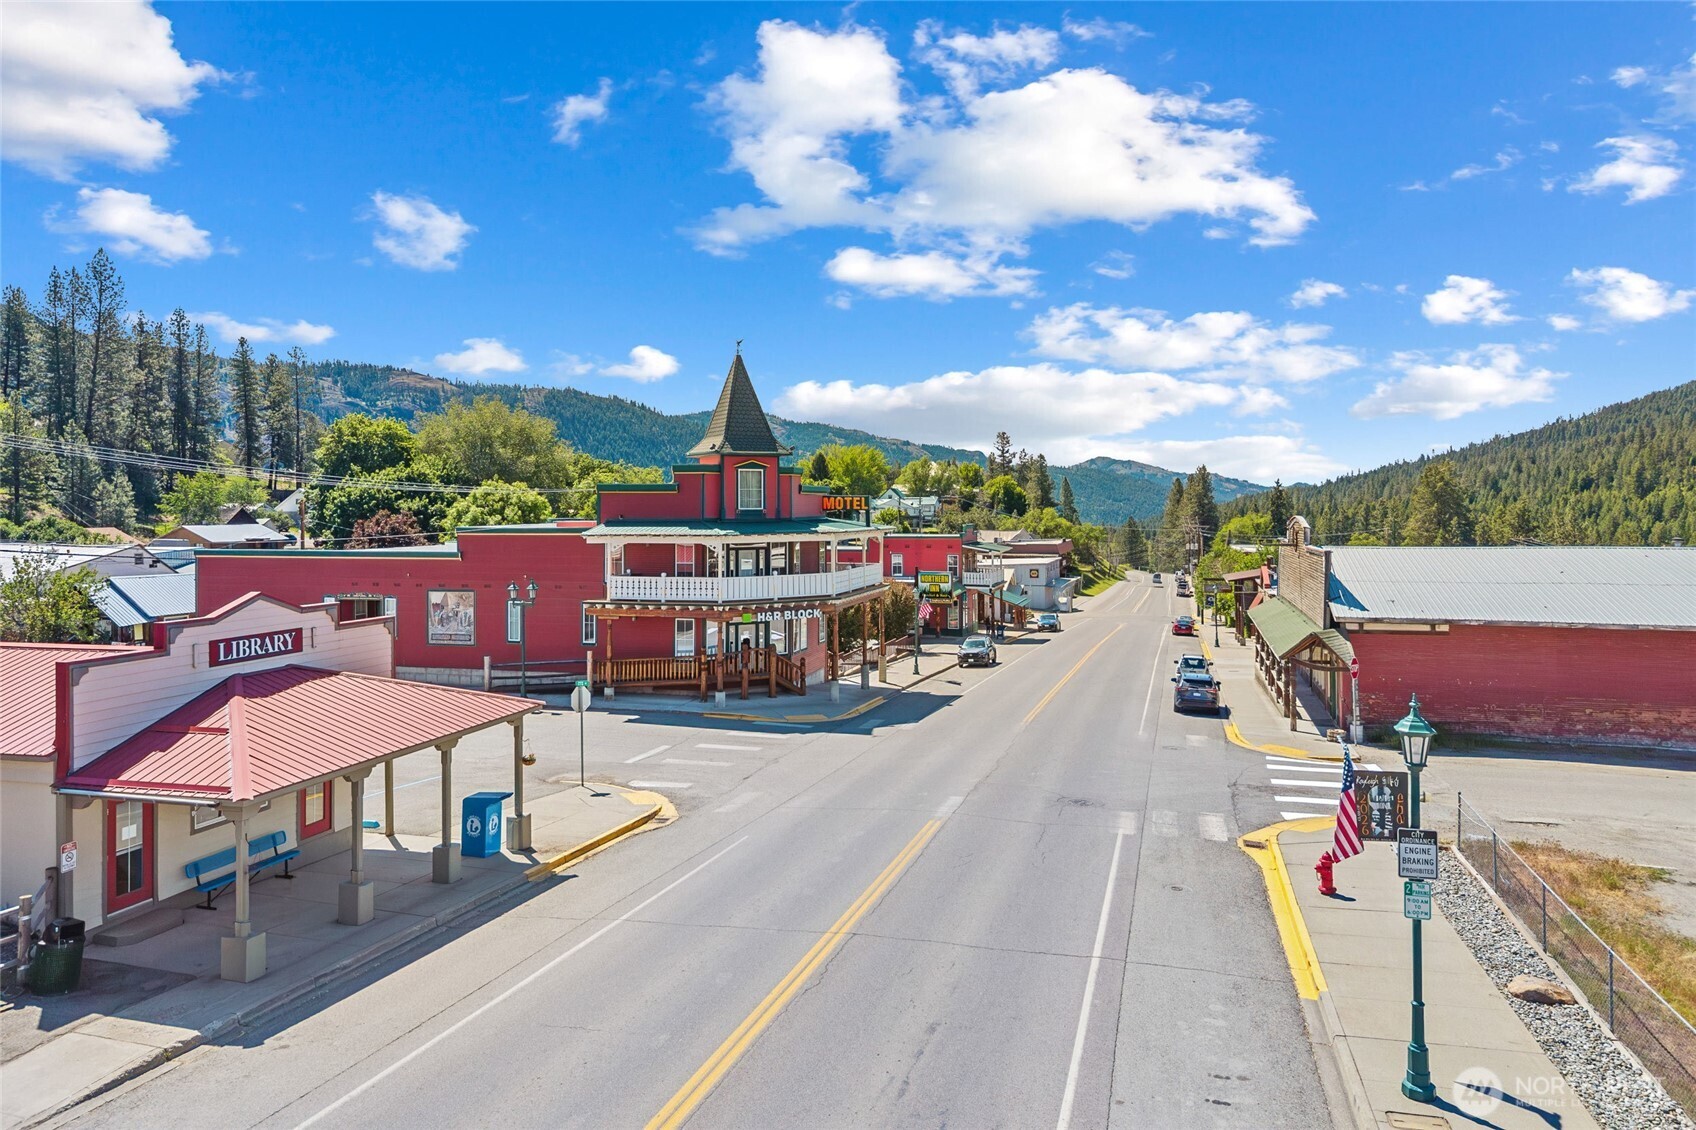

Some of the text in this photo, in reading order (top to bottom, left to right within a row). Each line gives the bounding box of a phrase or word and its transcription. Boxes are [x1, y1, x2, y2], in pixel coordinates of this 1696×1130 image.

[823, 496, 868, 510] MOTEL
[921, 575, 949, 583] NORTHERN
[930, 584, 940, 592] INN
[757, 609, 821, 622] H&R BLOCK
[218, 632, 296, 662] LIBRARY
[1360, 794, 1369, 836] 2026
[1405, 847, 1432, 855] ENGINE
[1402, 857, 1434, 866] BRAKING
[1406, 884, 1411, 894] 2
